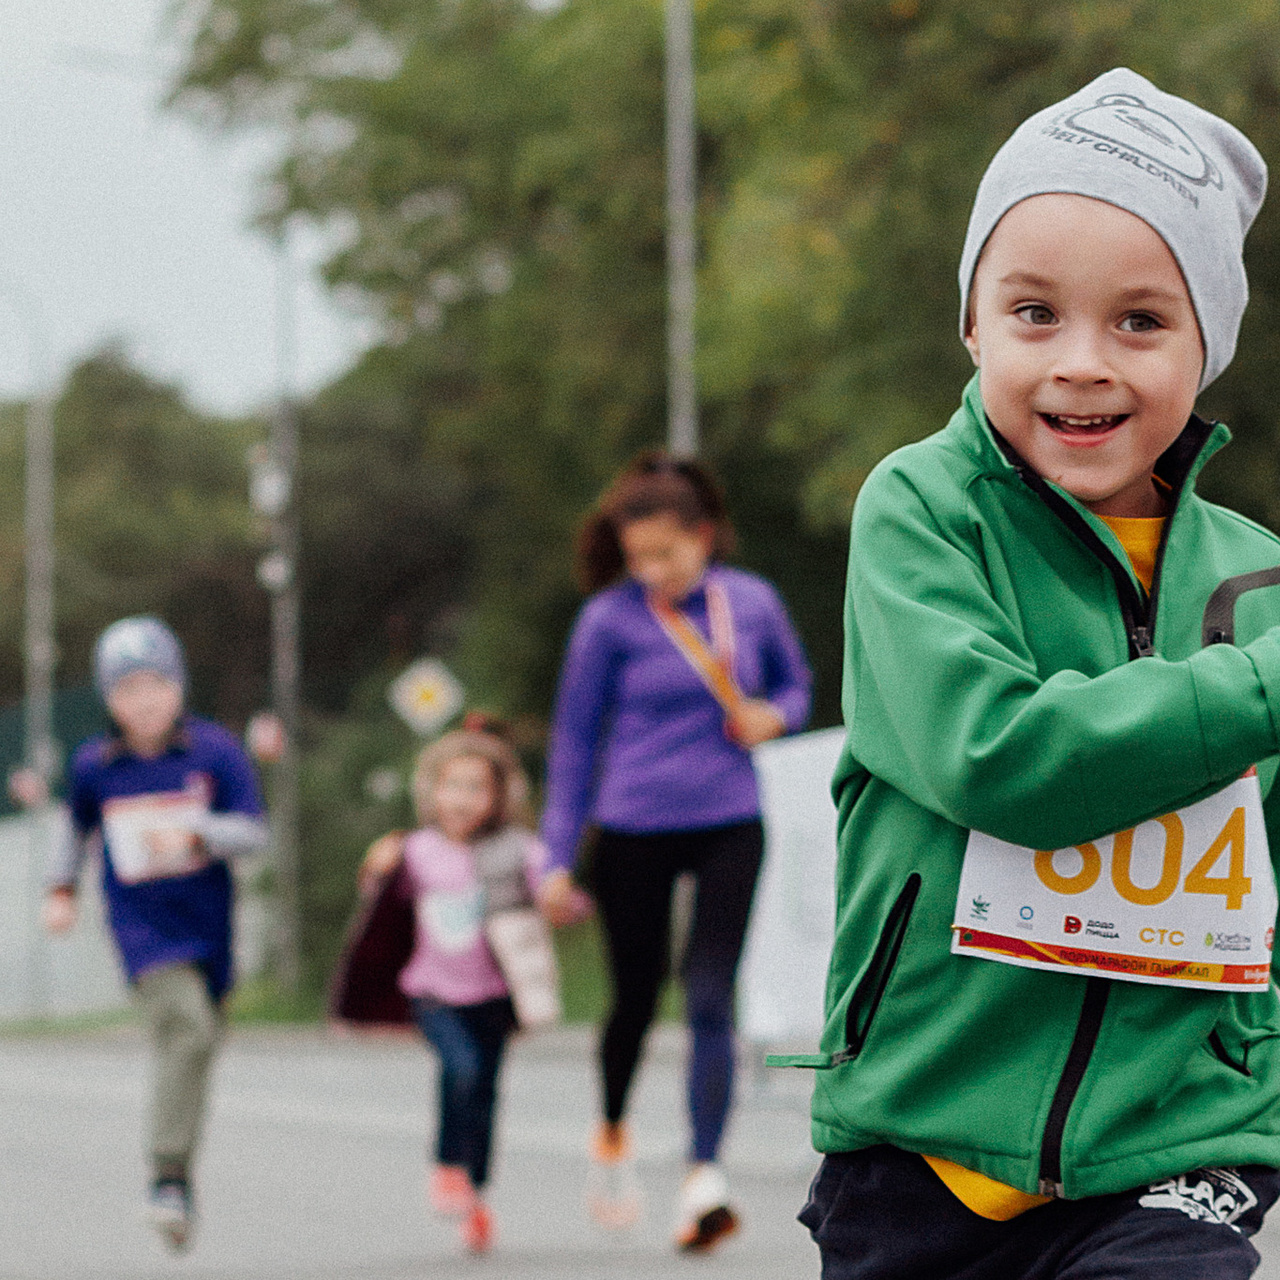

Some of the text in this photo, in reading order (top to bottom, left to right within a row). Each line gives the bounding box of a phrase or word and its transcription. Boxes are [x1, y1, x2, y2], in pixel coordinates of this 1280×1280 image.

[1086, 919, 1115, 930] ДОДО
[1085, 928, 1120, 939] ПИЦЦА
[1059, 949, 1147, 971] ПОЛУМАРАФОН
